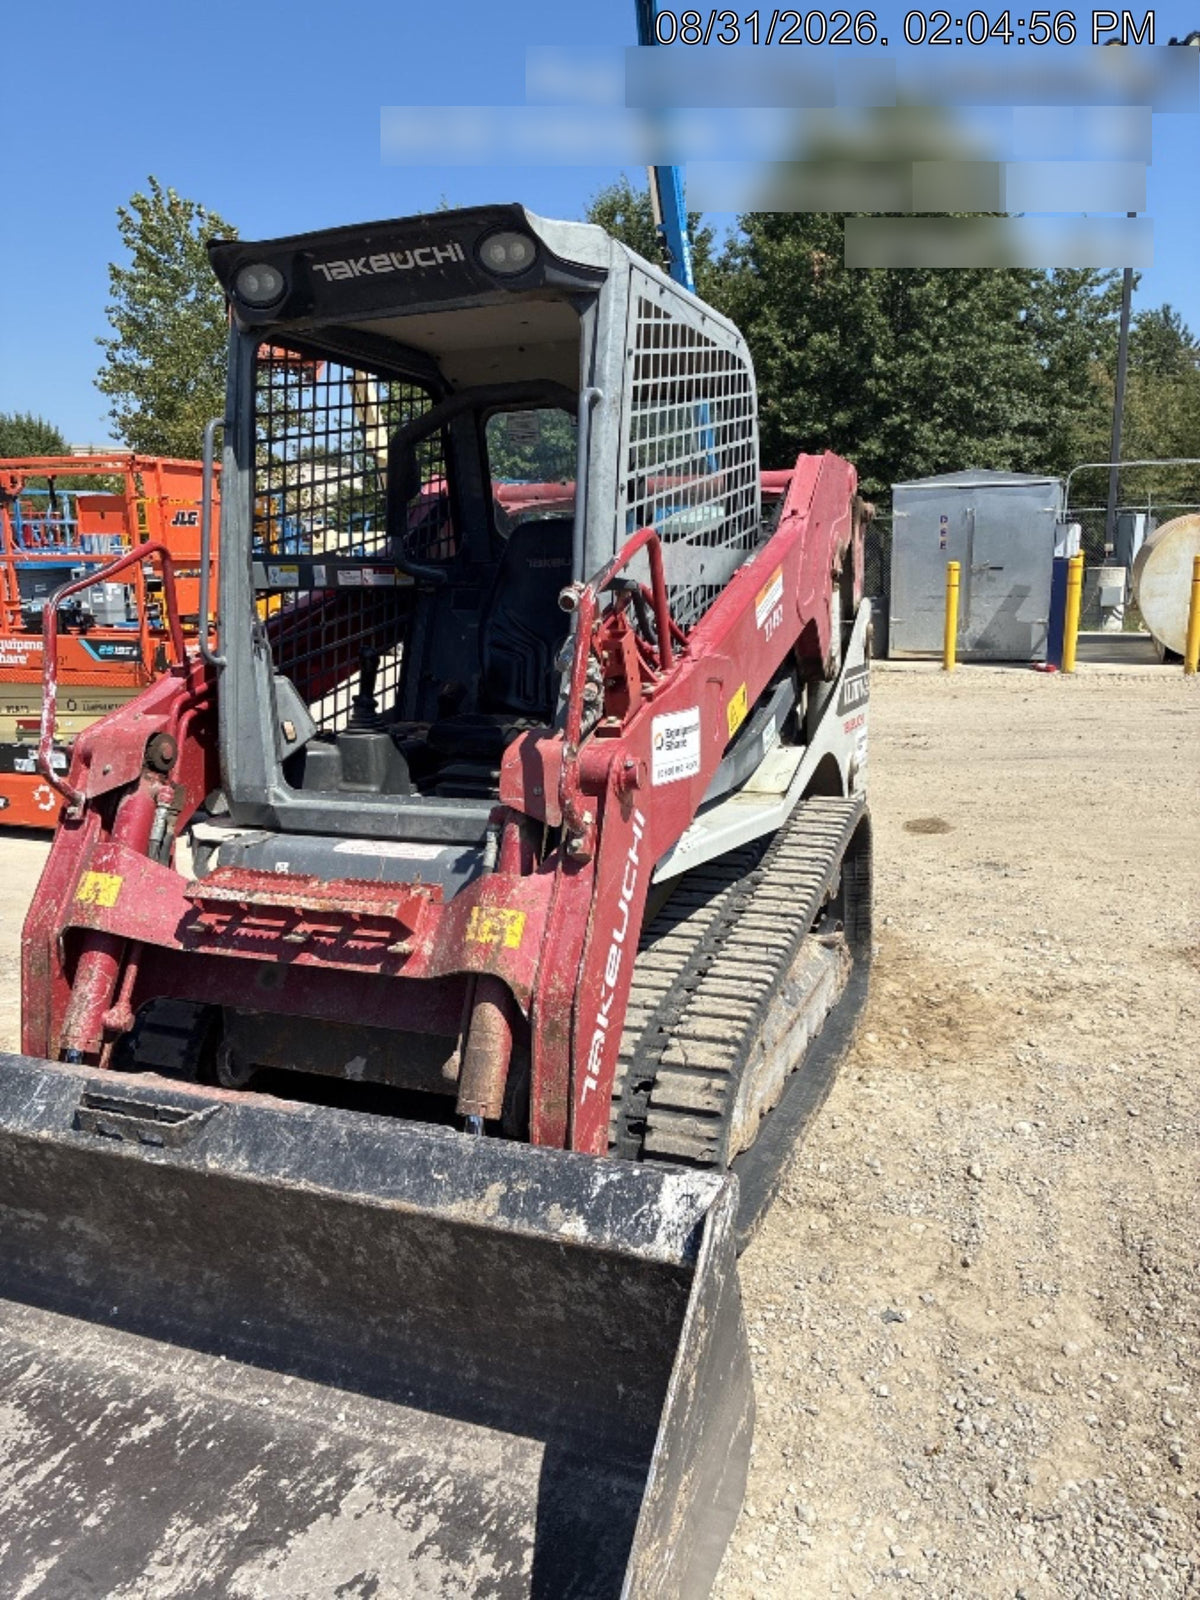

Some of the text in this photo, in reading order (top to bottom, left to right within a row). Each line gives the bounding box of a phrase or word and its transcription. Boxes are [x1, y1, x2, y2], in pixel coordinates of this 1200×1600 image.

[312, 242, 466, 282] TAKEUCHI
[171, 510, 199, 527] JLG
[0, 652, 27, 664] hare
[580, 808, 646, 1106] TAKEUCHI
